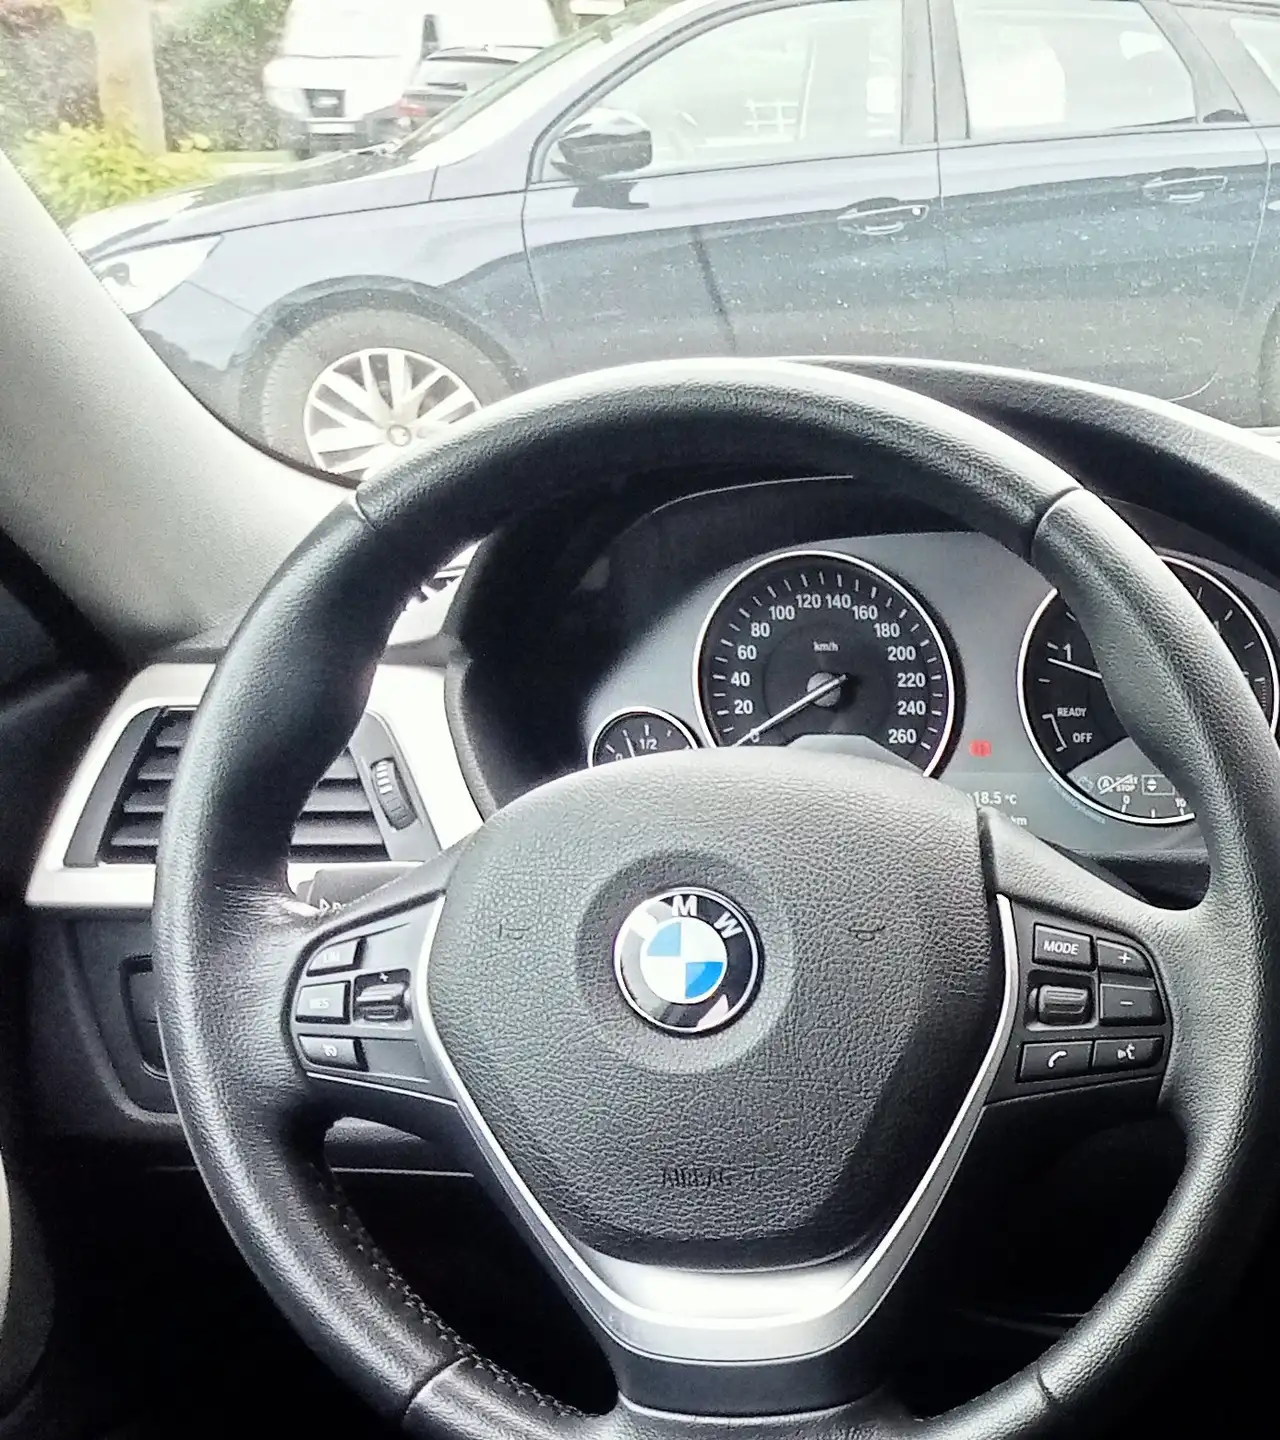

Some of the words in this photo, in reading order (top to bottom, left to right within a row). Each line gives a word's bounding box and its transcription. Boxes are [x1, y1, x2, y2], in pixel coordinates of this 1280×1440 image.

[796, 594, 821, 609] 120
[825, 594, 851, 609] 140
[769, 605, 795, 621] 100
[852, 605, 878, 621] 160
[750, 622, 770, 638] 80
[874, 622, 900, 638] 180
[737, 645, 757, 661] 60
[812, 640, 839, 653] km/h
[887, 645, 917, 661] 200
[1063, 643, 1073, 662] 1
[730, 671, 751, 687] 40
[897, 672, 926, 688] 220
[734, 699, 754, 715] 20
[897, 699, 927, 715] 240
[1056, 706, 1087, 717] READY
[888, 728, 917, 744] 260
[1072, 732, 1093, 743] OFF
[639, 738, 658, 751] 1/2
[1042, 939, 1080, 955] MODE
